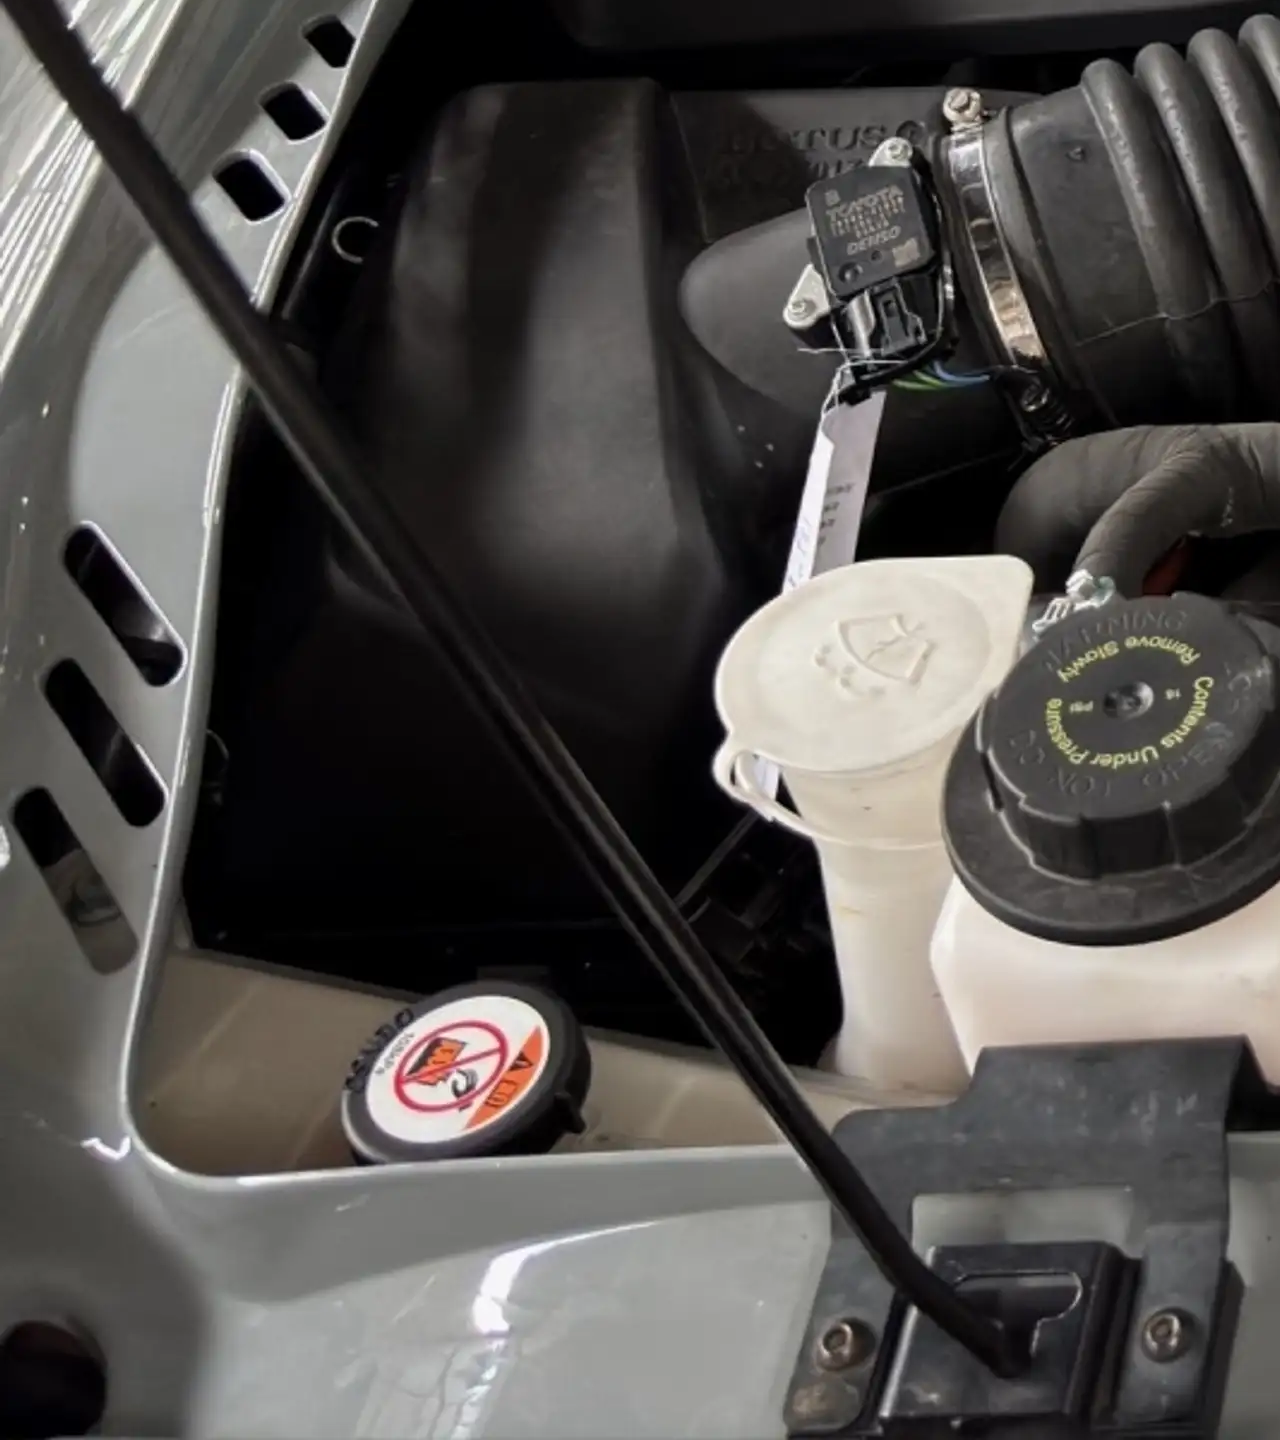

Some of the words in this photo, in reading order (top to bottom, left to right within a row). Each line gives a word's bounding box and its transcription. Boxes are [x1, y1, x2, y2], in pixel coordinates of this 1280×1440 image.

[846, 225, 901, 256] DENSO
[1056, 640, 1120, 683] Slowly
[1124, 635, 1201, 666] Remove
[1069, 700, 1094, 714] PSI
[1159, 676, 1214, 748] Contents
[1046, 697, 1091, 765] Pressure
[1089, 745, 1160, 770] Under
